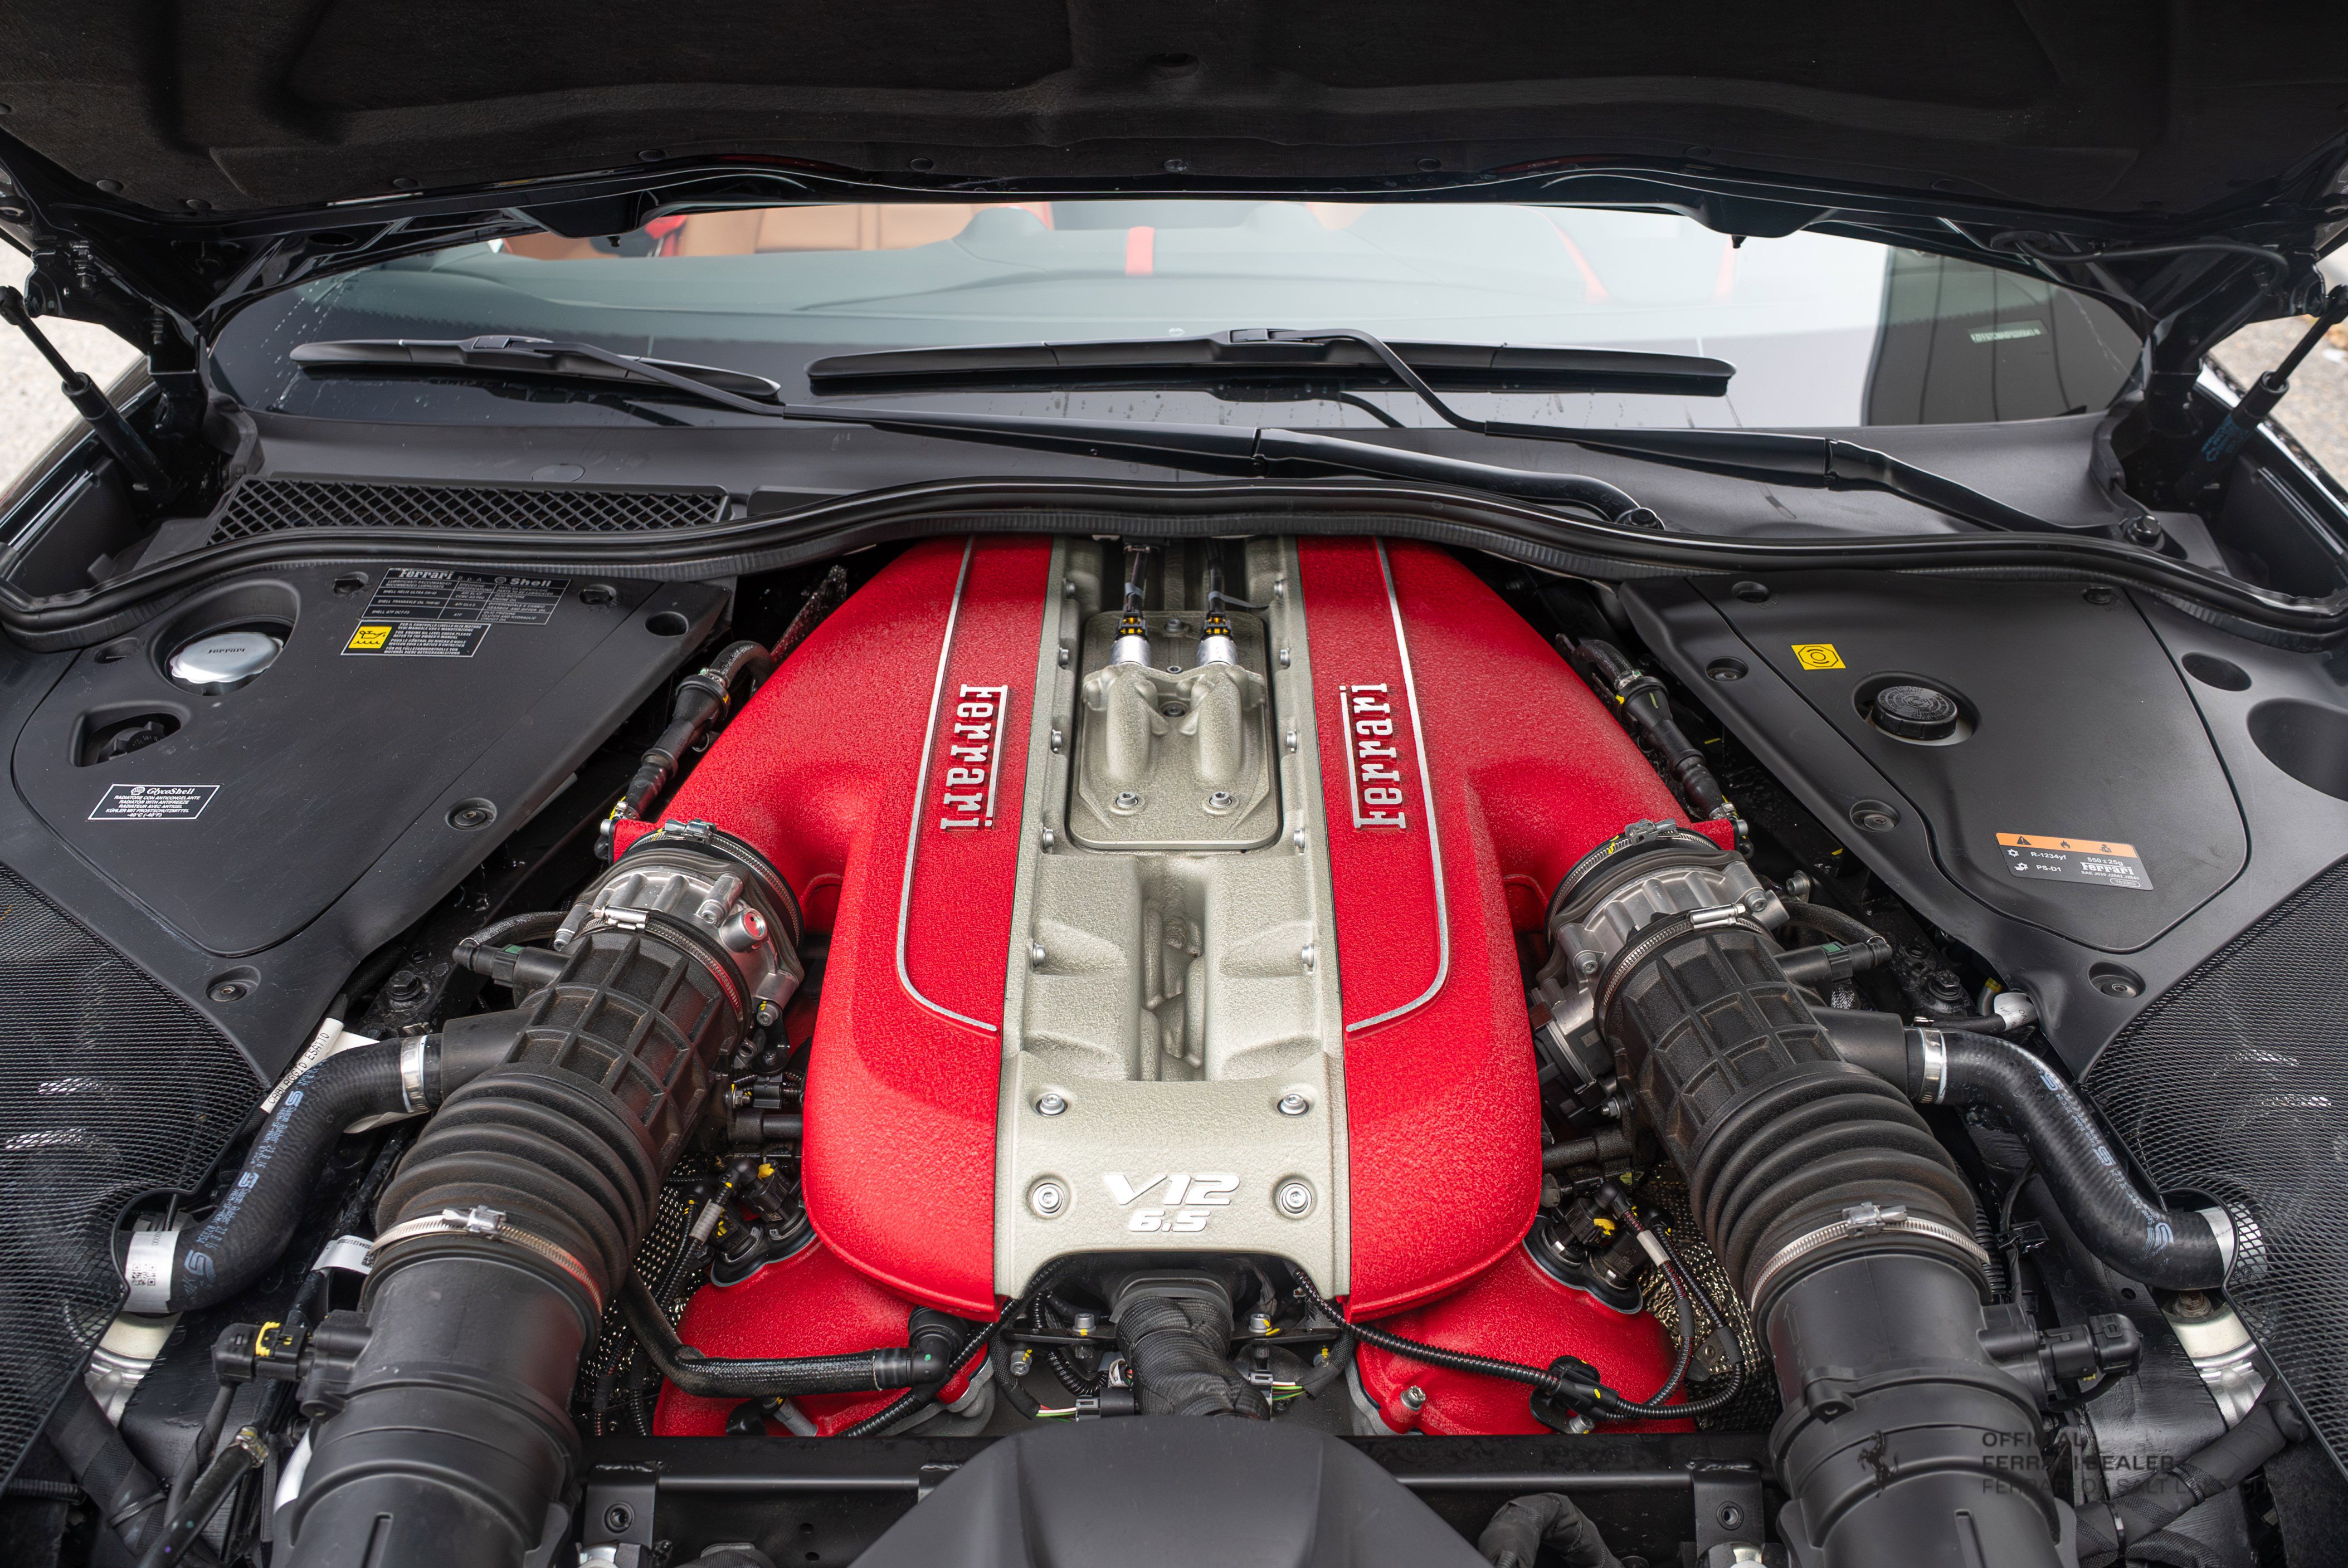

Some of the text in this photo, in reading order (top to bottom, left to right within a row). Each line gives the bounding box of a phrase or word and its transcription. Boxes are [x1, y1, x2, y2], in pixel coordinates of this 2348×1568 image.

[398, 569, 455, 580] Ferrari
[510, 578, 552, 587] Shell
[940, 683, 1009, 829] Ferrari
[1339, 683, 1406, 829] Ferrari
[2030, 852, 2066, 860] R-1234yf
[2080, 862, 2135, 875] Ferrari
[267, 1062, 308, 1105] CABLAGGIO
[305, 1032, 330, 1061] ESATTO
[2071, 1113, 2085, 1131] Rubber
[270, 1124, 288, 1144] Rubber
[264, 1145, 276, 1154] 23
[1102, 1174, 1241, 1205] V12
[220, 1205, 240, 1225] Rubber
[1128, 1210, 1211, 1232] 6.5
[213, 1225, 227, 1235] 23
